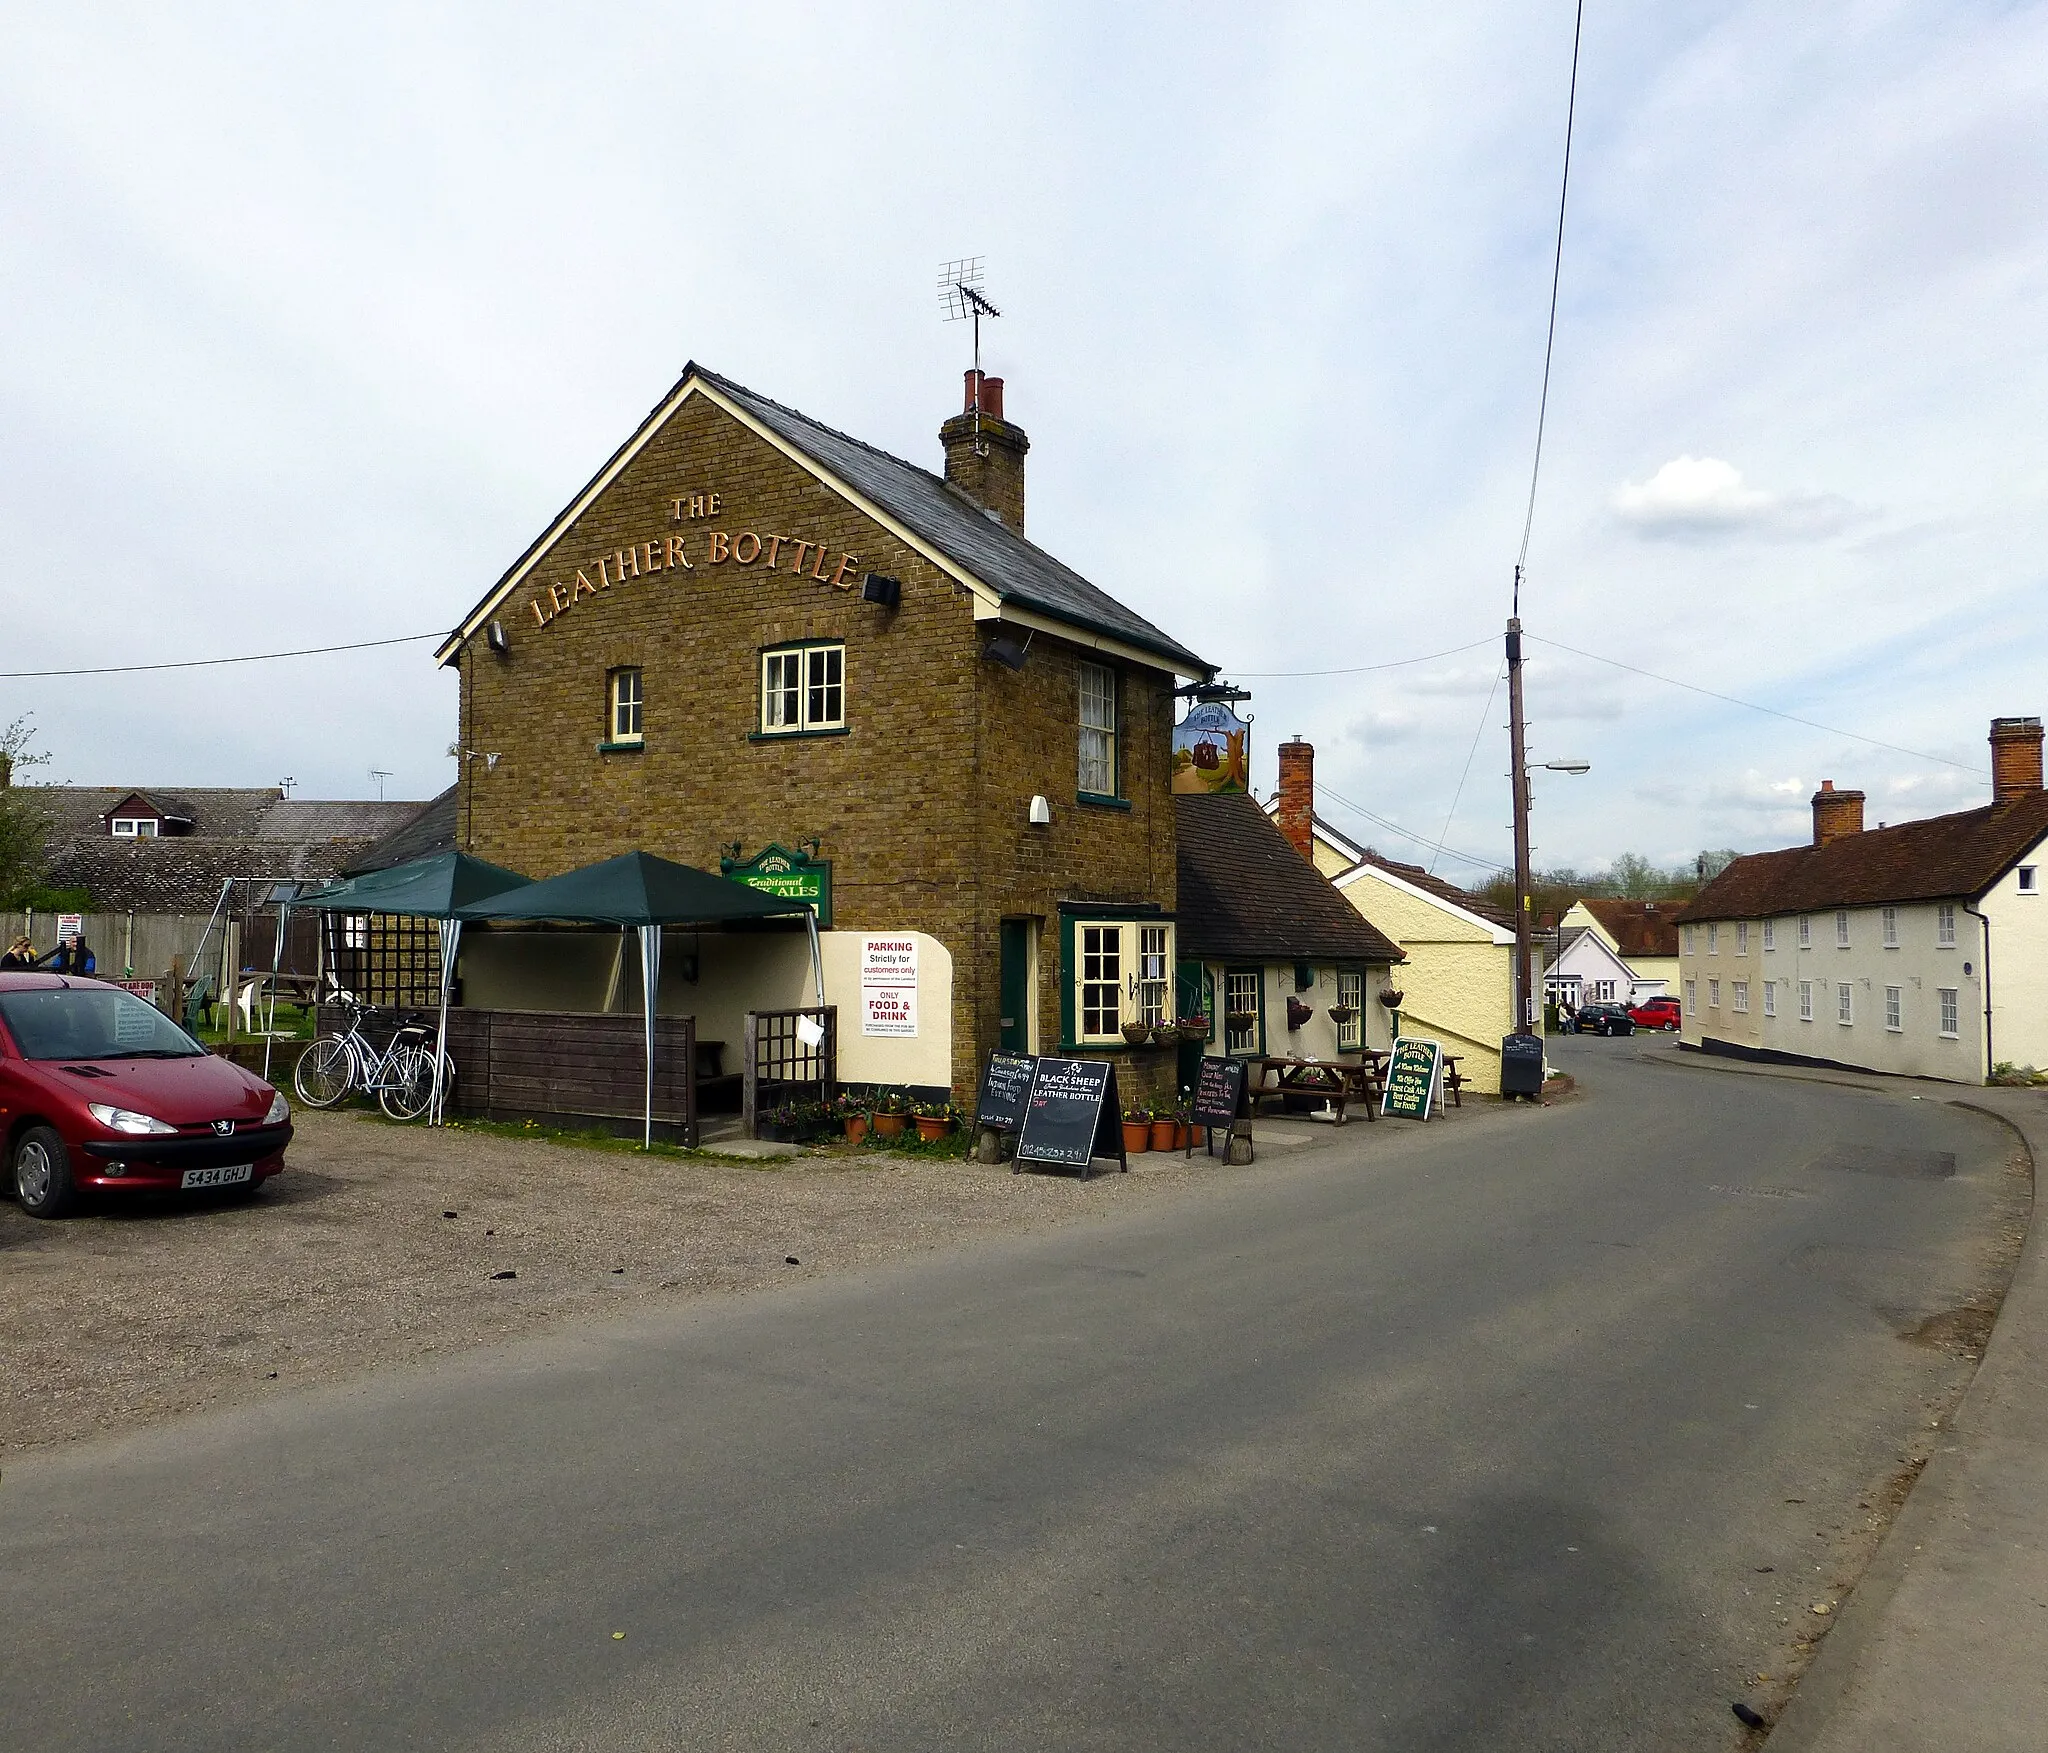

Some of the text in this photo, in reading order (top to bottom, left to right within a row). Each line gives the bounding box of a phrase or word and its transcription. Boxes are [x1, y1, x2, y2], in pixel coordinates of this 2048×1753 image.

[672, 493, 721, 520] THE
[530, 532, 859, 628] LEATHER BOTTLE
[1205, 706, 1227, 720] LEATHER
[759, 856, 791, 871] THE LEATHER
[766, 865, 784, 874] BOTTLE
[748, 877, 803, 886] Traditional
[778, 886, 818, 896] ALES
[868, 942, 912, 952] PARKING
[870, 954, 896, 964] Strictly
[864, 966, 916, 976] customers only
[869, 1000, 910, 1010] FOOD &
[873, 1012, 907, 1020] DRINK
[1396, 1042, 1434, 1061] THE LEATHER
[1403, 1051, 1426, 1062] BOTTLE
[1040, 1074, 1100, 1086] BLACK SHEEP
[1390, 1083, 1403, 1091] Finest
[1415, 1087, 1426, 1095] Ales
[1034, 1089, 1100, 1102] LEATHER BOTTLE
[1392, 1092, 1420, 1102] Beer Garden
[188, 1166, 246, 1185] S434 GHJ
